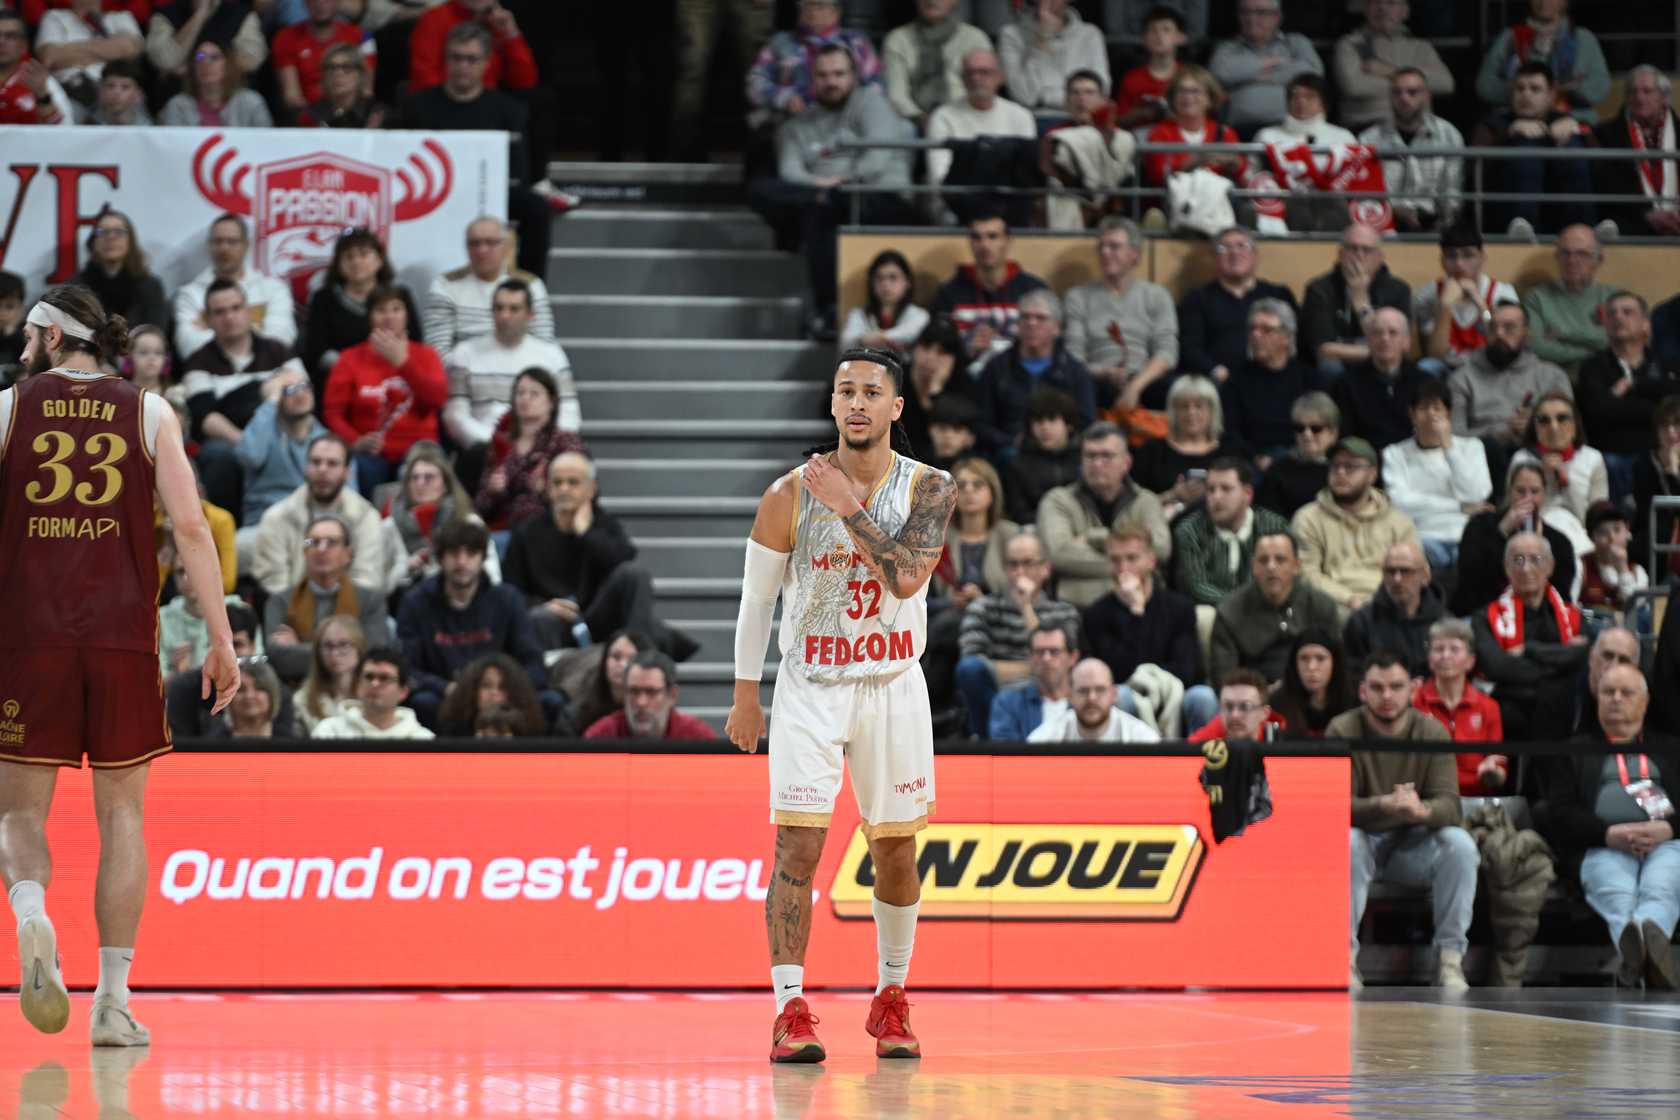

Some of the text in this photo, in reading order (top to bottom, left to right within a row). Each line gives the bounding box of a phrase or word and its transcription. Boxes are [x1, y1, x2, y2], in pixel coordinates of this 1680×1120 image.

[269, 187, 380, 232] PASSION
[42, 398, 116, 422] GOLDEN
[25, 430, 128, 506] 33
[846, 580, 882, 620] 32
[804, 629, 914, 666] FEDCOM
[160, 846, 383, 904] Quand
[388, 857, 472, 899] on
[481, 846, 599, 900] est
[975, 840, 1176, 890] JOUE
